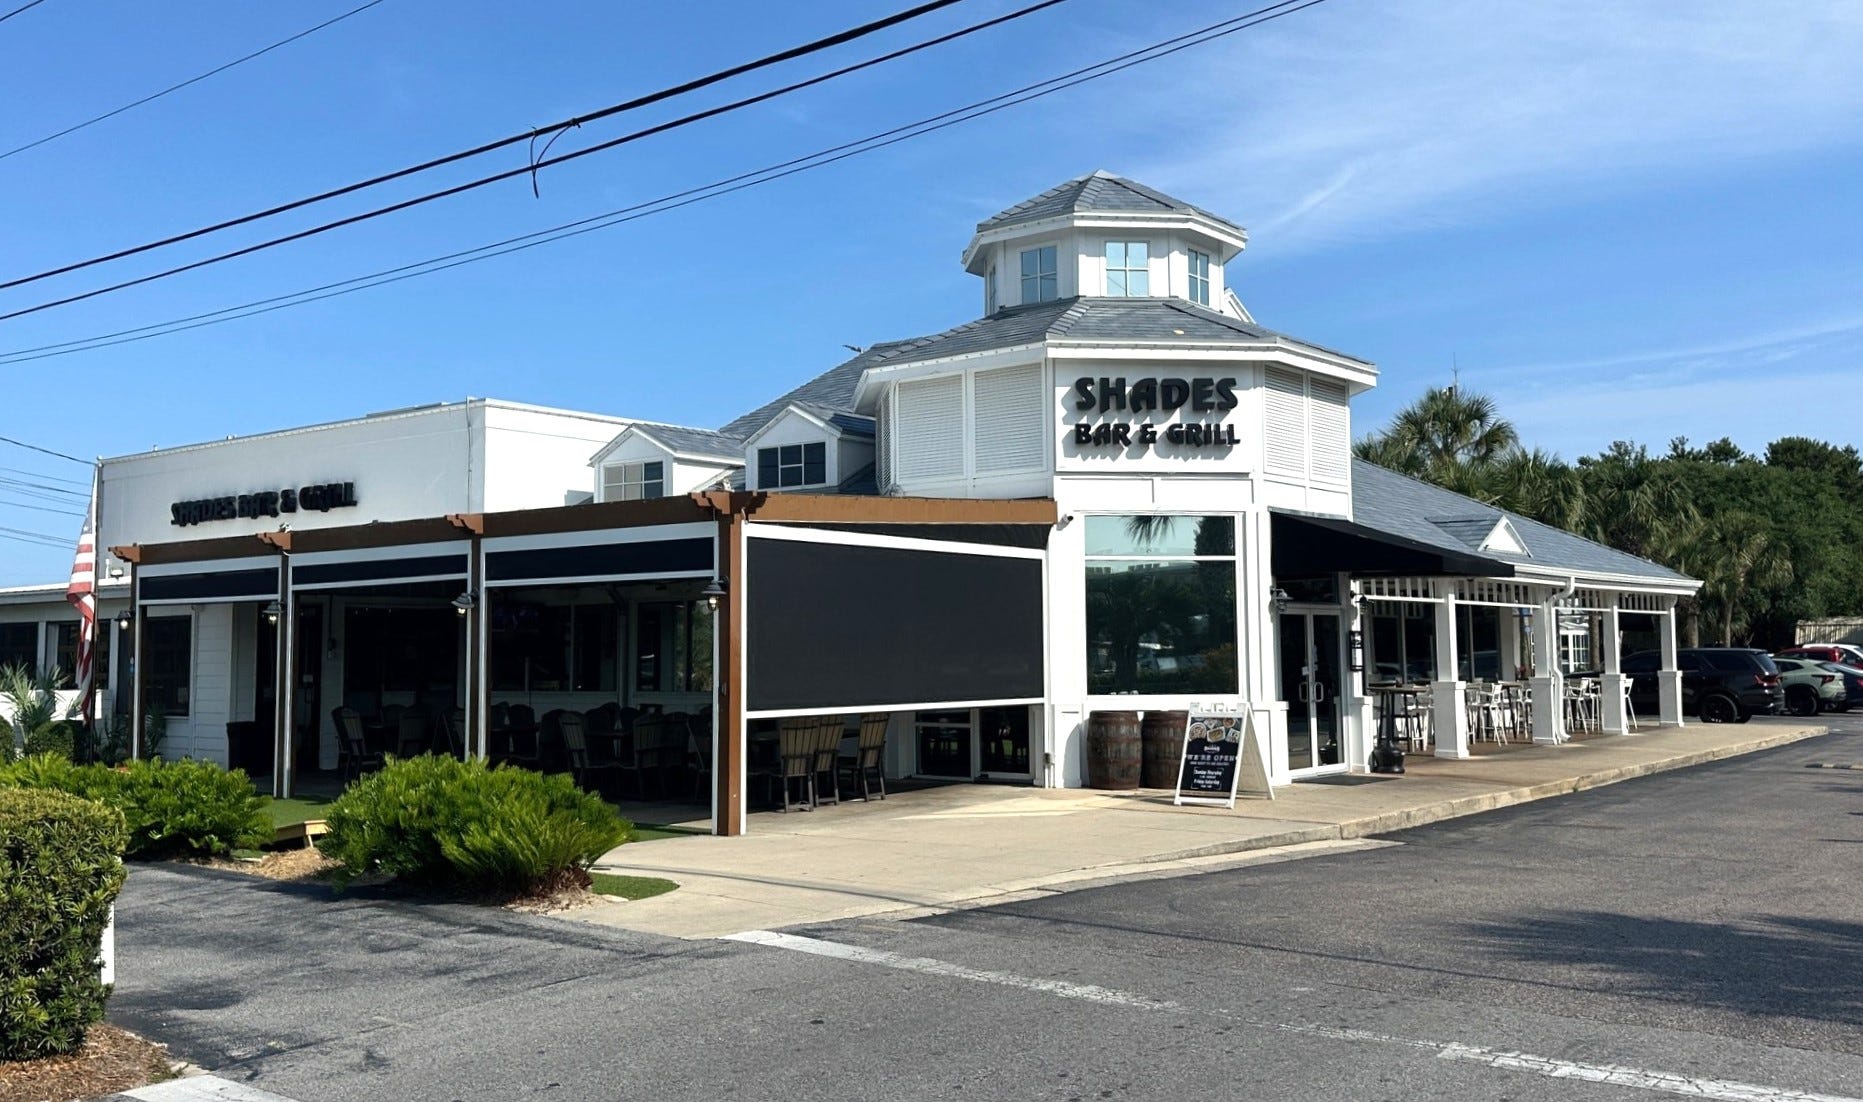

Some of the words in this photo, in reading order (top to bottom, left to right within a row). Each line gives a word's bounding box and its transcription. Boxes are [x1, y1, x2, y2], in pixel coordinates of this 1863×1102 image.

[1075, 377, 1238, 413] SHADES
[1075, 423, 1131, 447] BAR
[1139, 423, 1157, 444] &
[1166, 423, 1240, 447] GRILL
